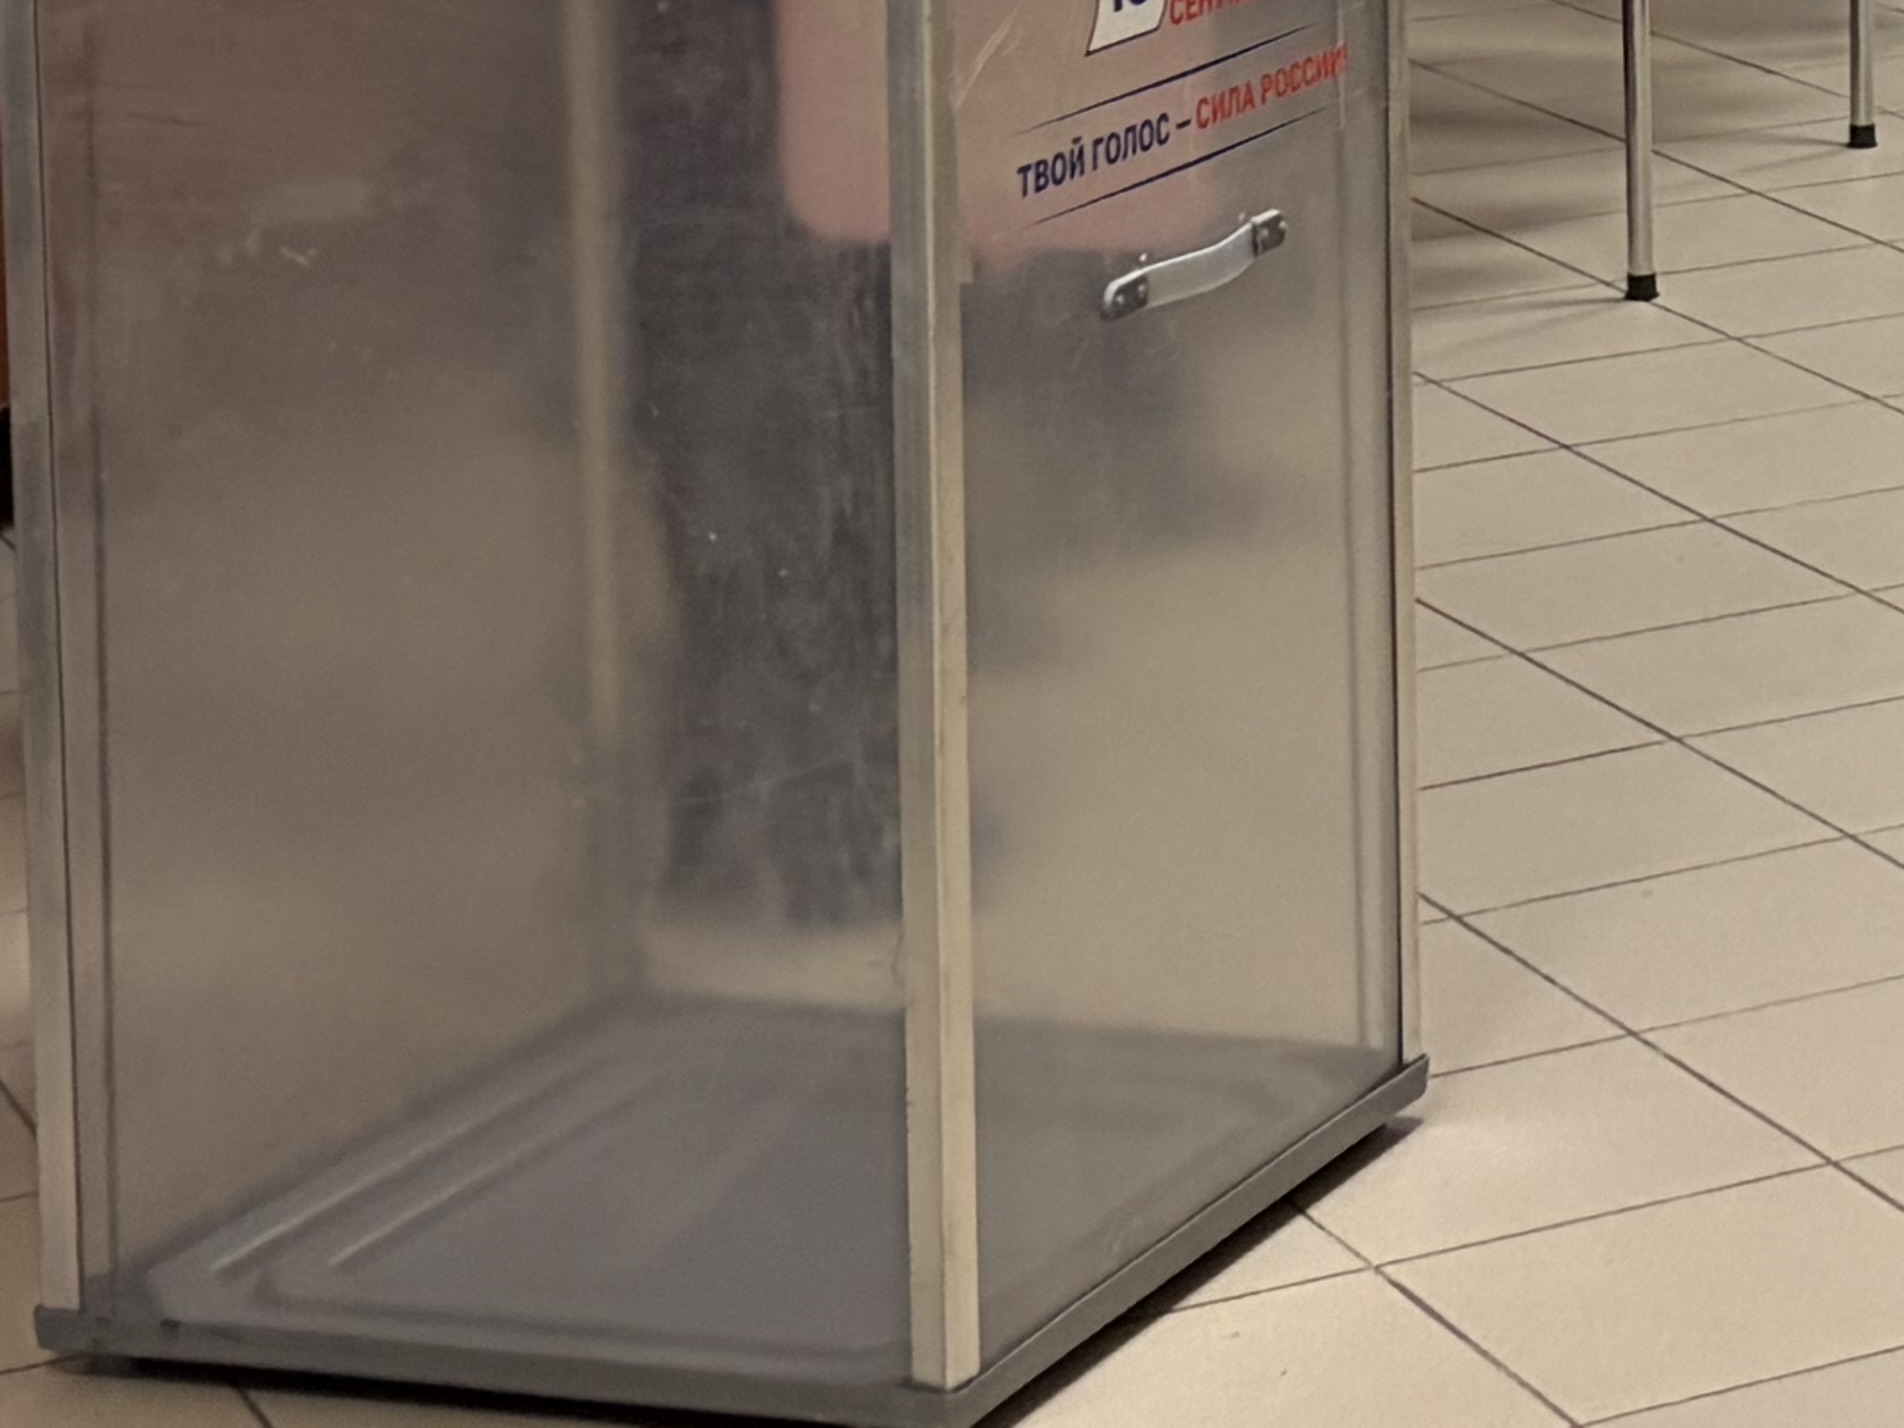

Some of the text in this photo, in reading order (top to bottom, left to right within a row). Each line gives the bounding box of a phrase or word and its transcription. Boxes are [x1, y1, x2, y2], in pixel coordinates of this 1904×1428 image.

[1016, 136, 1085, 199] ТВОЙ
[1091, 111, 1170, 172] ГОЛОС
[1195, 87, 1256, 131] СИЛА
